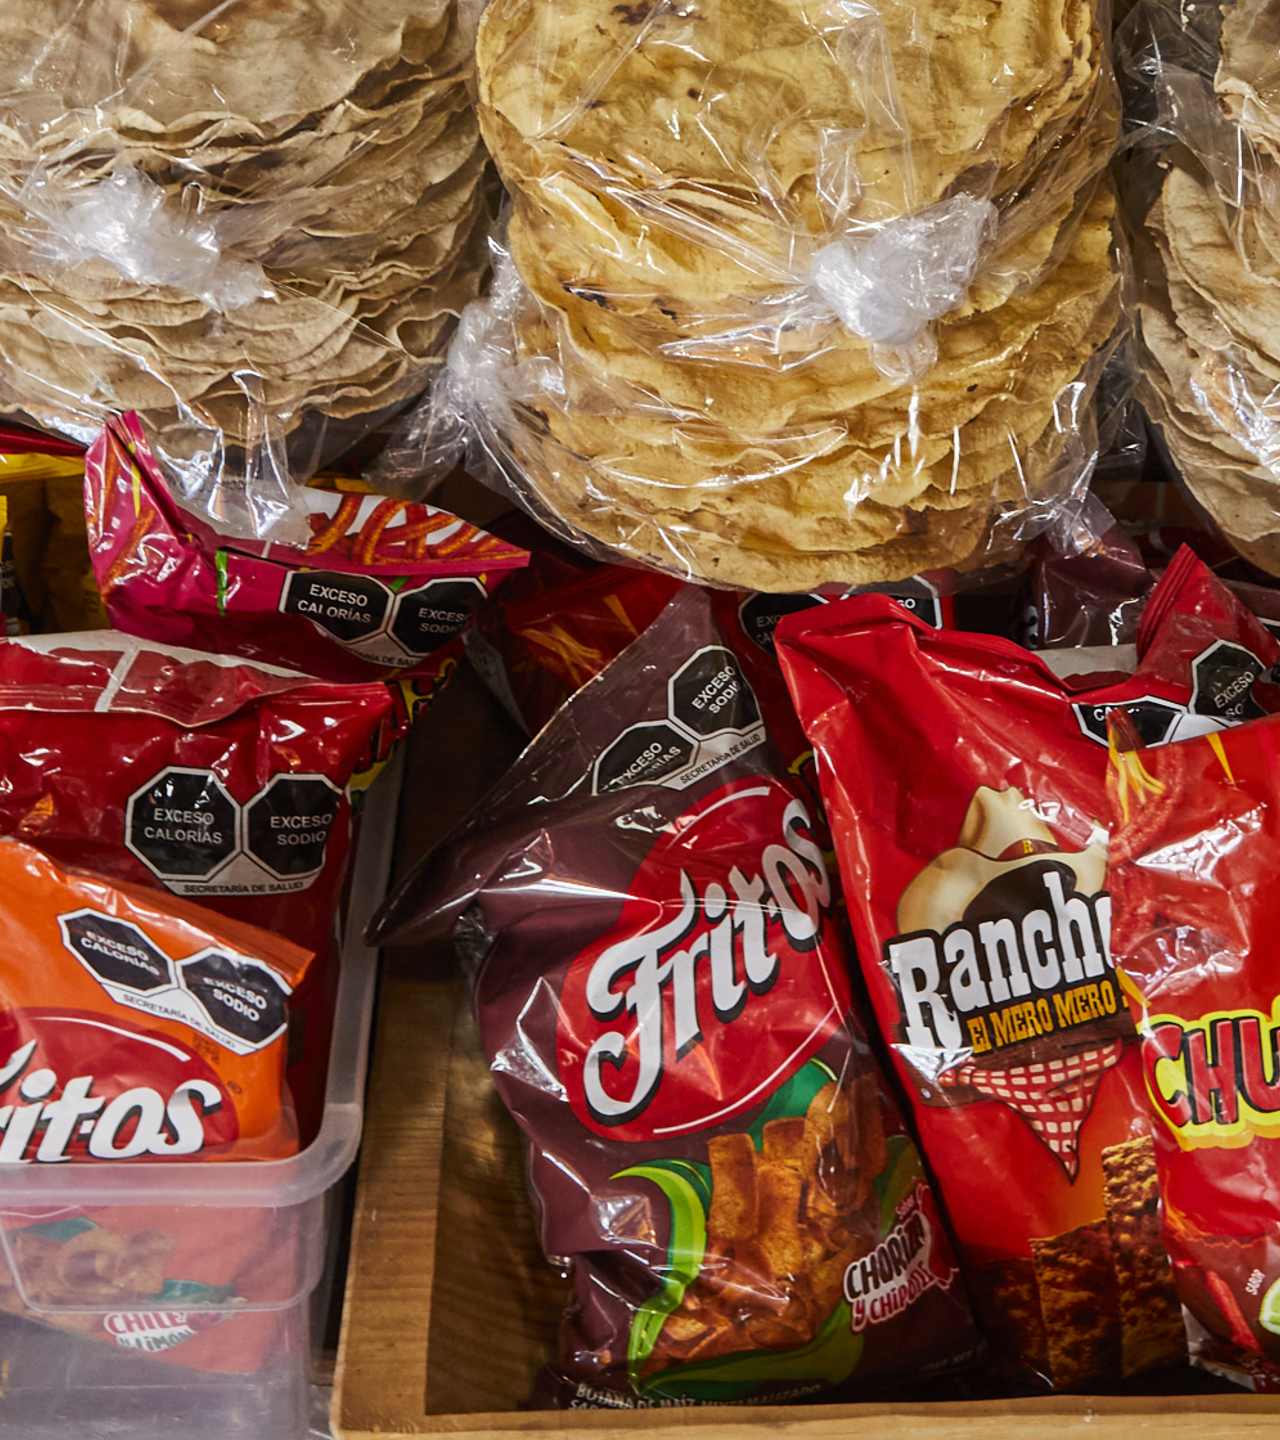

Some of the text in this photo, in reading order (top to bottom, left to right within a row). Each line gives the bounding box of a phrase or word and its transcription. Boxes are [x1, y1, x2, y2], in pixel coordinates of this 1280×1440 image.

[309, 583, 368, 607] EXCESO
[692, 665, 736, 710] EXCESO
[1212, 671, 1256, 708] EXCESO
[730, 733, 762, 754] DE SALUD
[153, 807, 215, 825] EXCESO
[270, 813, 333, 830] EXCESO
[144, 826, 223, 844] CALORÍAS
[277, 831, 328, 846] SODIO
[184, 881, 304, 894] SECRETARÍA DE SALUD
[86, 931, 149, 961] EXCESO
[581, 798, 832, 1120] Fritos
[202, 976, 268, 1010] EXCESO
[212, 988, 260, 1022] SODIO
[994, 979, 1118, 1047] MERO MERO
